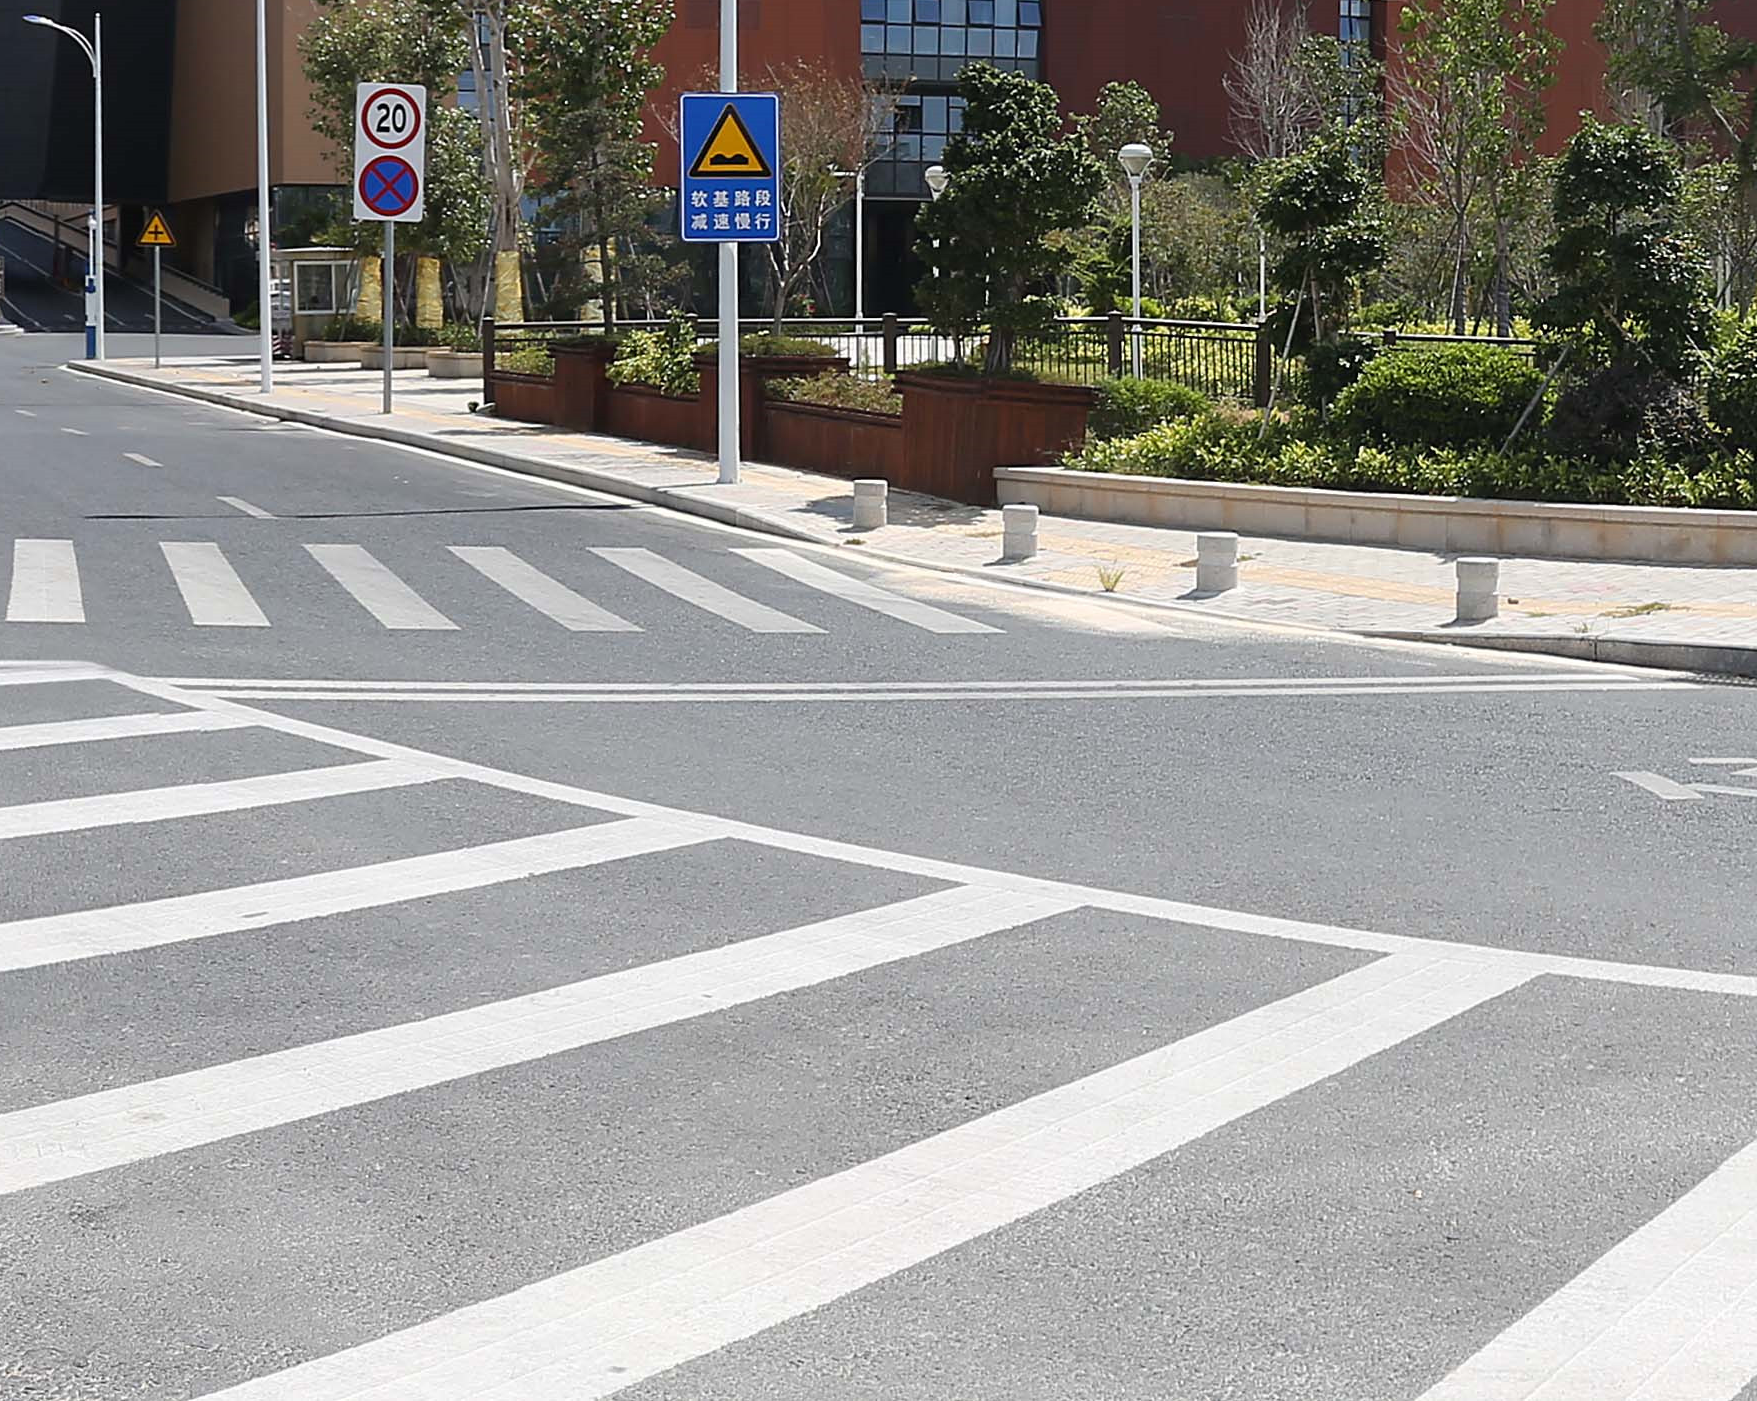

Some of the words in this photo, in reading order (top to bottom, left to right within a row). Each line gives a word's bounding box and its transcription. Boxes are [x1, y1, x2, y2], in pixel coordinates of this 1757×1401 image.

[376, 102, 407, 133] 20
[690, 189, 772, 208] 软基路段
[690, 212, 772, 231] 减速慢行
